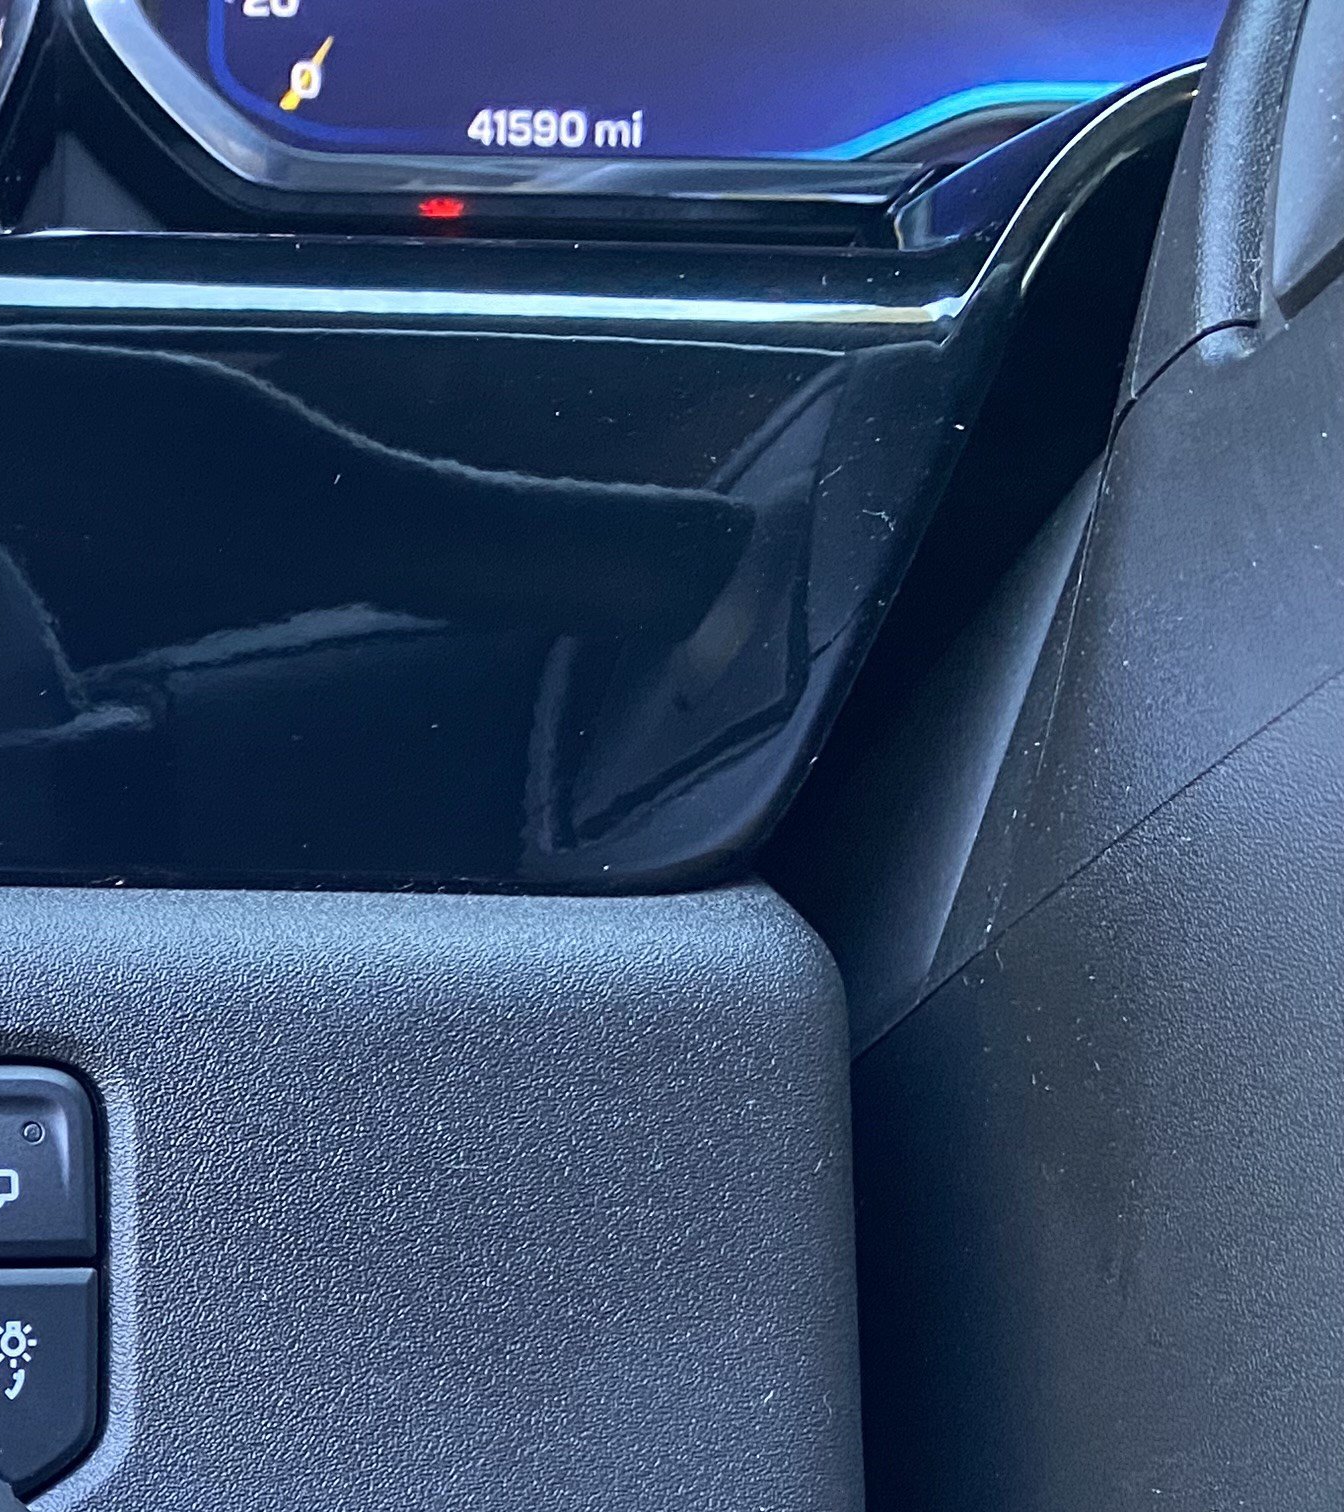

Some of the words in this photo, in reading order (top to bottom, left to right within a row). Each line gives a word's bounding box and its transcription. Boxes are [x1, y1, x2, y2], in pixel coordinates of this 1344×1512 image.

[291, 60, 322, 99] 0
[467, 108, 587, 147] 41590
[594, 109, 643, 148] mi
